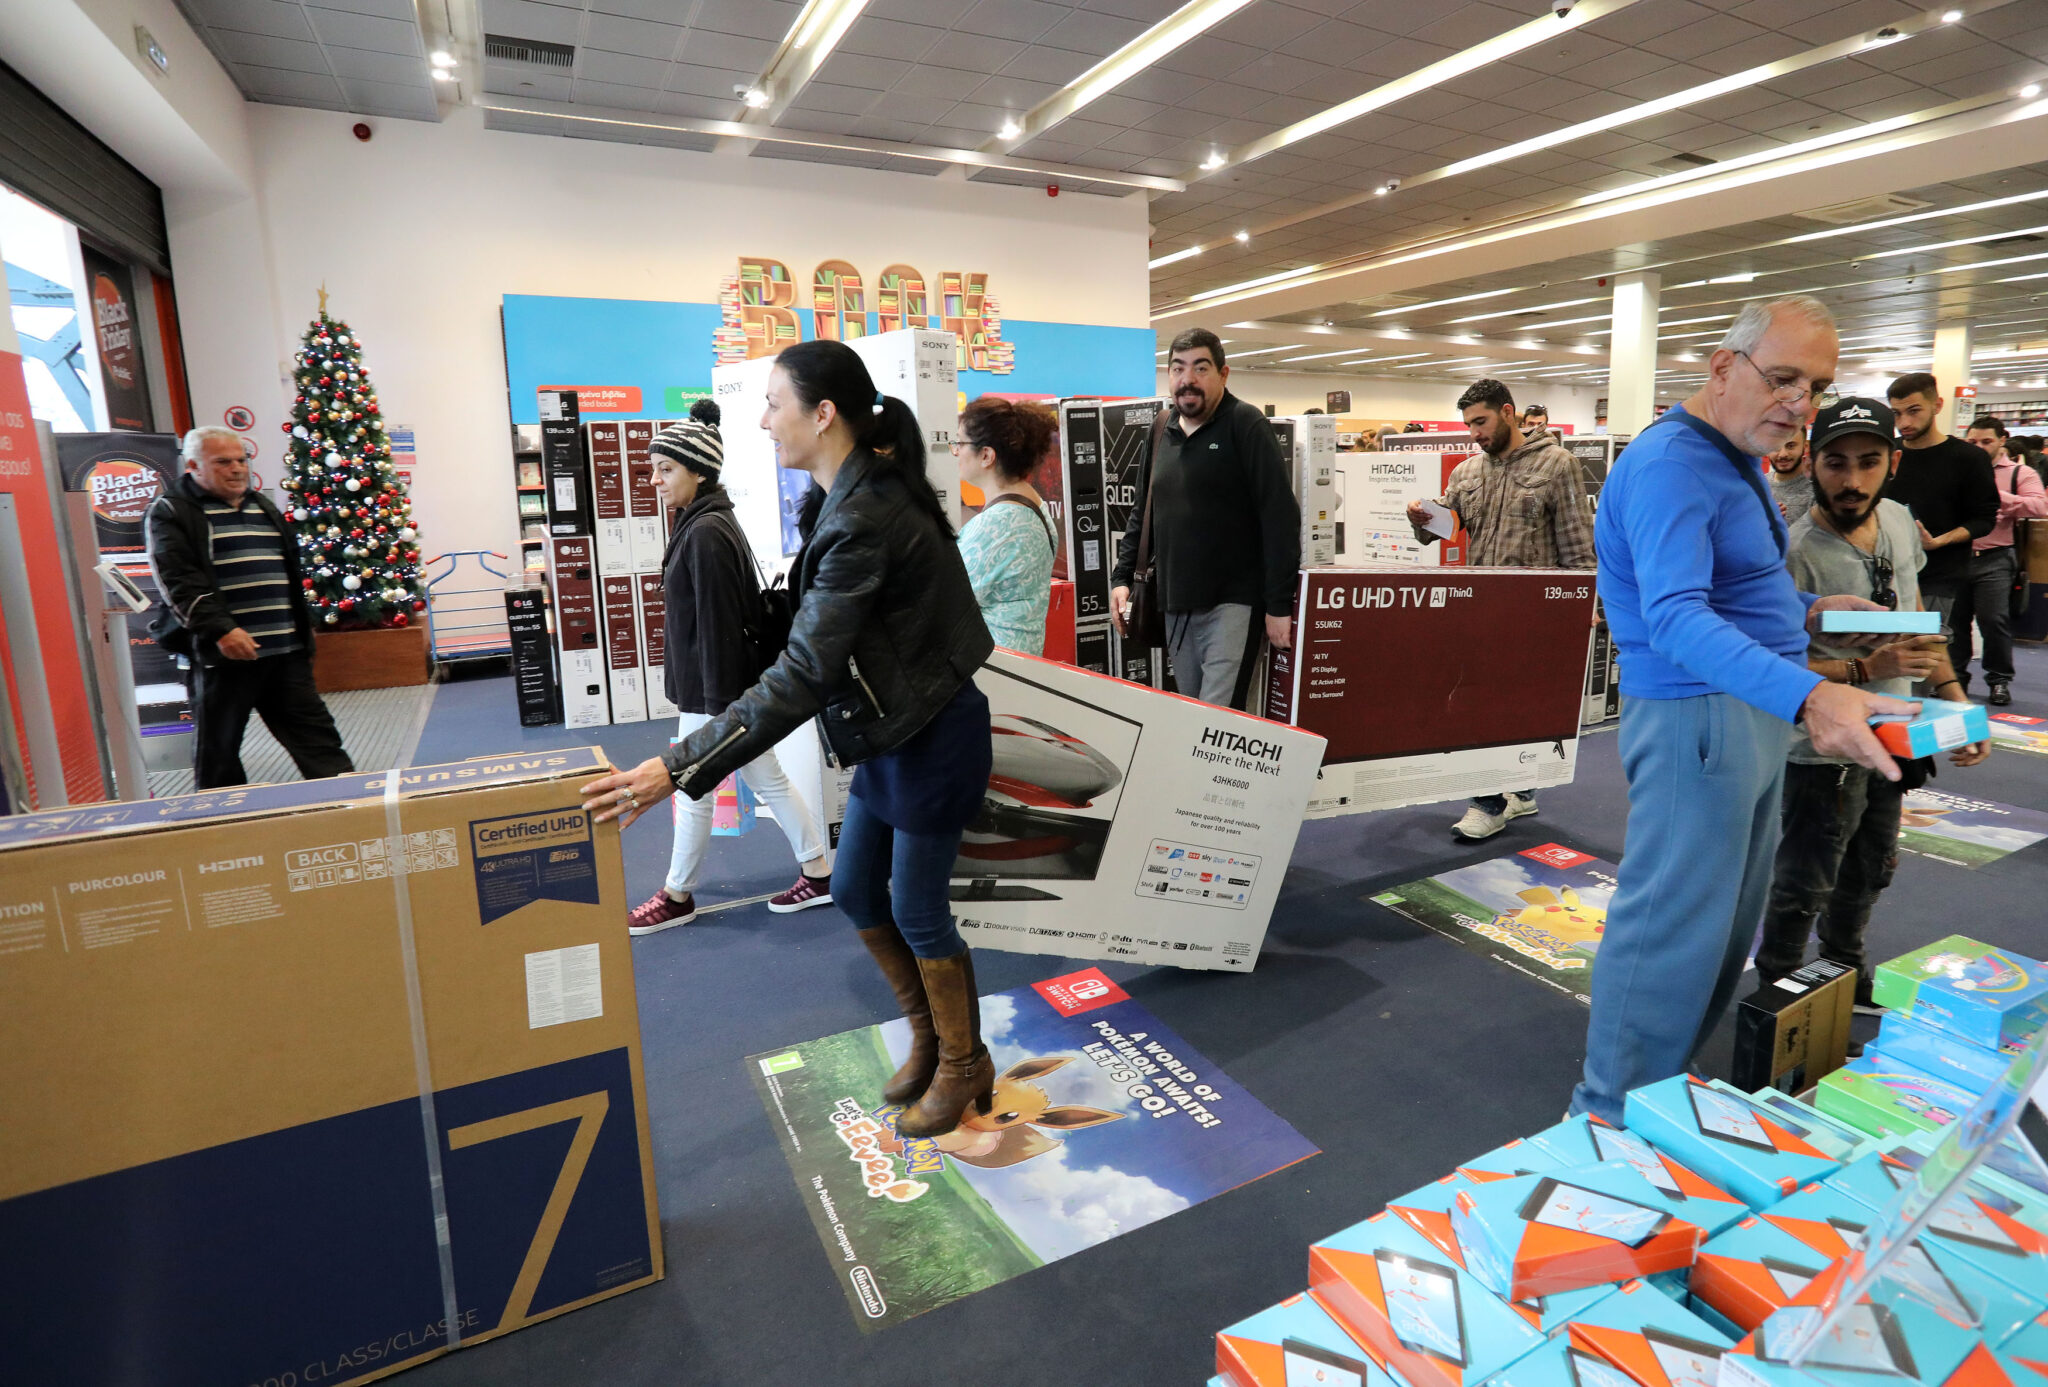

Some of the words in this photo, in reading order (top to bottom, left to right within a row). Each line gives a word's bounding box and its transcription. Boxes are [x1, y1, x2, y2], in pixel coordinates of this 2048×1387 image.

[738, 256, 989, 371] BOOK
[922, 341, 950, 350] SONY
[718, 382, 743, 395] SONY
[90, 468, 158, 492] Black
[1368, 476, 1389, 484] Inspire
[1371, 464, 1415, 475] HITACHI
[94, 485, 158, 506] Friday
[571, 546, 583, 554] LG
[1081, 594, 1099, 612] 55
[1316, 587, 1345, 609] LG
[1351, 587, 1395, 609] UHD
[1399, 586, 1427, 608] TV
[1431, 589, 1444, 604] AI
[1448, 587, 1473, 599] ThinQ
[1315, 620, 1343, 629] 55UK62
[1320, 666, 1338, 674] Display
[1606, 704, 1615, 713] 49
[1201, 727, 1283, 762] HITACHI
[364, 757, 568, 790] SAMSUNG
[1192, 746, 1232, 765] Inspire
[1234, 757, 1252, 770] the
[1255, 761, 1281, 777] Next
[1212, 775, 1250, 790] 43HK6000
[479, 820, 548, 842] Certified
[551, 815, 584, 831] UHD
[1175, 808, 1202, 819] Japanese
[1203, 814, 1223, 823] quality
[1235, 820, 1261, 830] reliability
[1214, 825, 1225, 833] 100
[1226, 828, 1241, 836] years
[199, 855, 264, 874] HDMI
[297, 846, 347, 867] BACK
[68, 869, 167, 894] PURCOLOUR
[1474, 924, 1586, 970] Pikachu!
[1491, 953, 1504, 961] The
[1504, 960, 1537, 977] Pokémon
[1537, 975, 1573, 993] Company
[1046, 985, 1076, 1010] SWITCH
[1054, 983, 1082, 1007] NINTENDO
[1091, 1020, 1161, 1076] POKÉMON
[1152, 1076, 1222, 1129] AWAITS!
[1129, 1032, 1148, 1043] A
[1143, 1041, 1197, 1083] WORLD
[1193, 1084, 1223, 1102] OF
[1081, 1041, 1138, 1083] LET'S
[1127, 1083, 1178, 1119] GO!
[840, 1099, 861, 1121] Let's
[840, 1119, 929, 1201] Eevee!
[447, 1089, 610, 1330] 7
[811, 1174, 823, 1190] The
[818, 1189, 840, 1224] Pokémon
[833, 1223, 857, 1262] Company
[854, 1269, 879, 1314] Nintendo
[304, 1308, 480, 1382] CLASS/CLASSE
